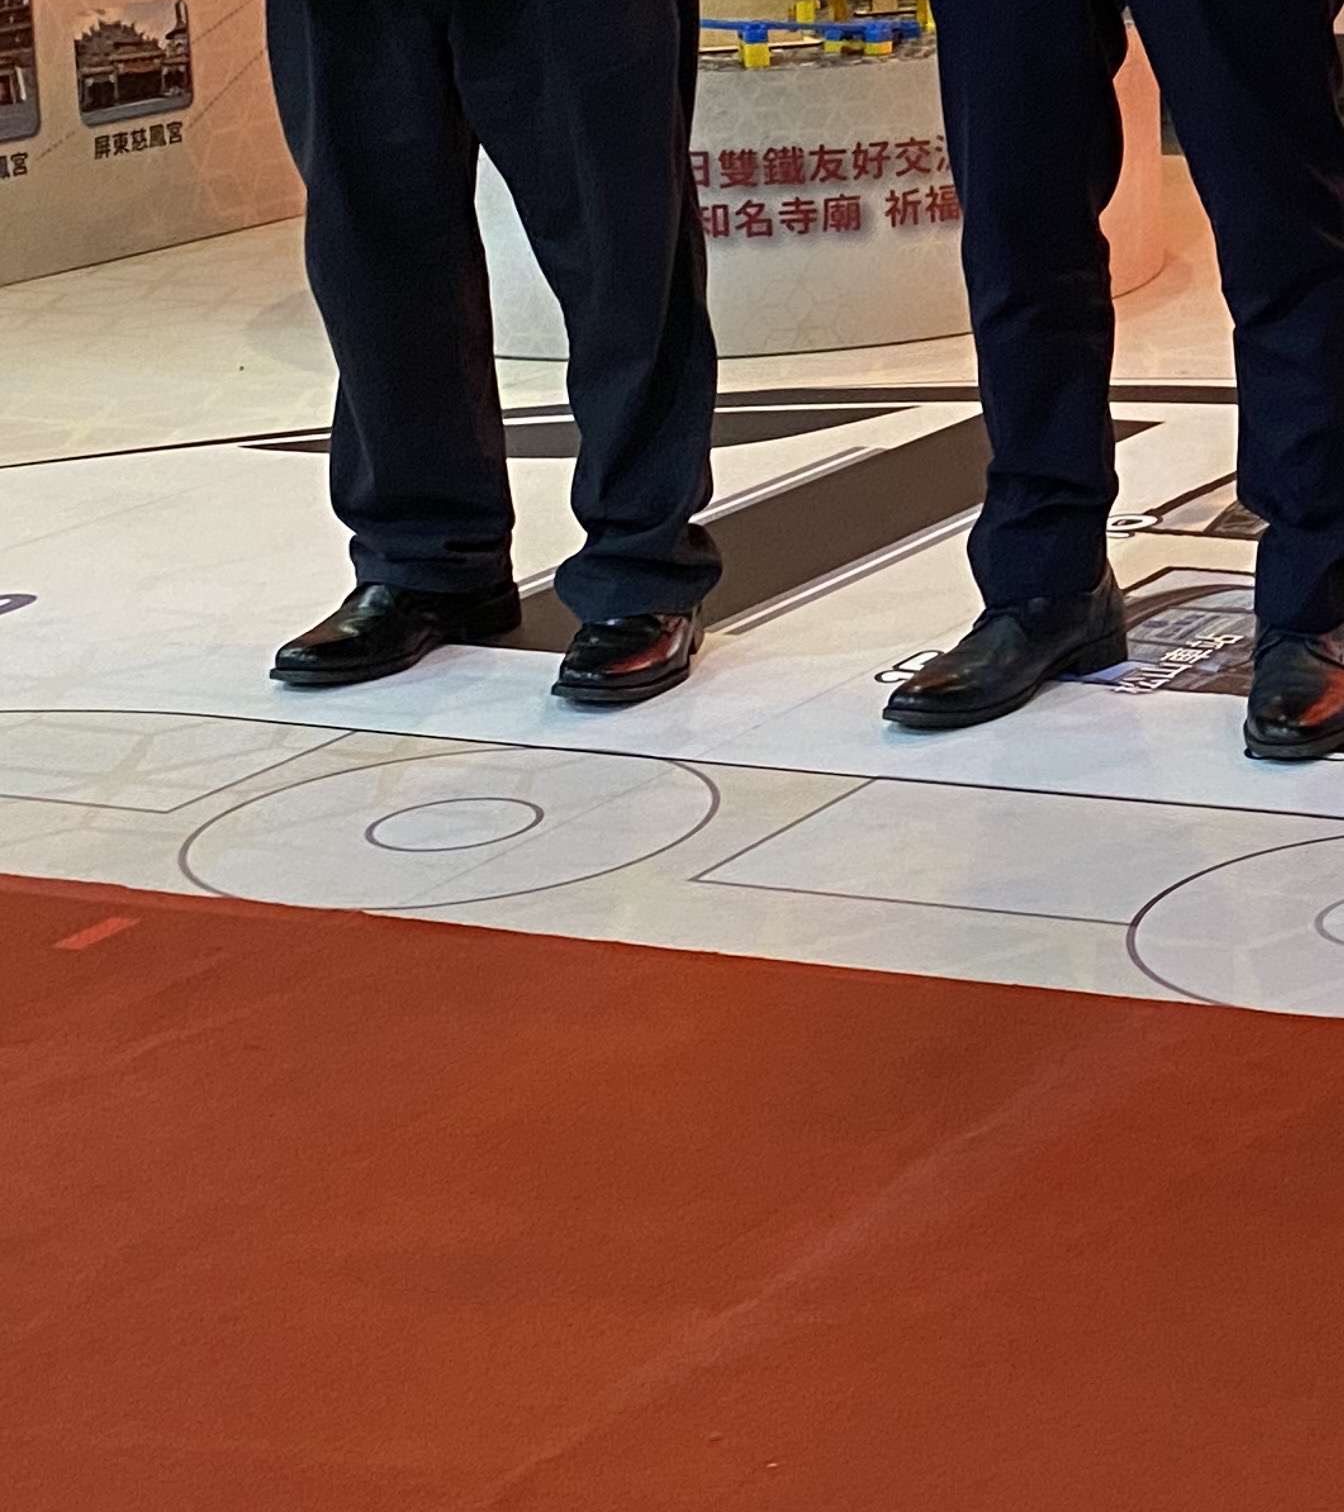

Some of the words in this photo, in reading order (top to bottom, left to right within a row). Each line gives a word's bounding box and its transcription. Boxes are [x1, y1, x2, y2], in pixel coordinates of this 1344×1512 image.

[94, 122, 184, 160] 屏東慈鳳宮
[1114, 627, 1246, 695] 松山車站
